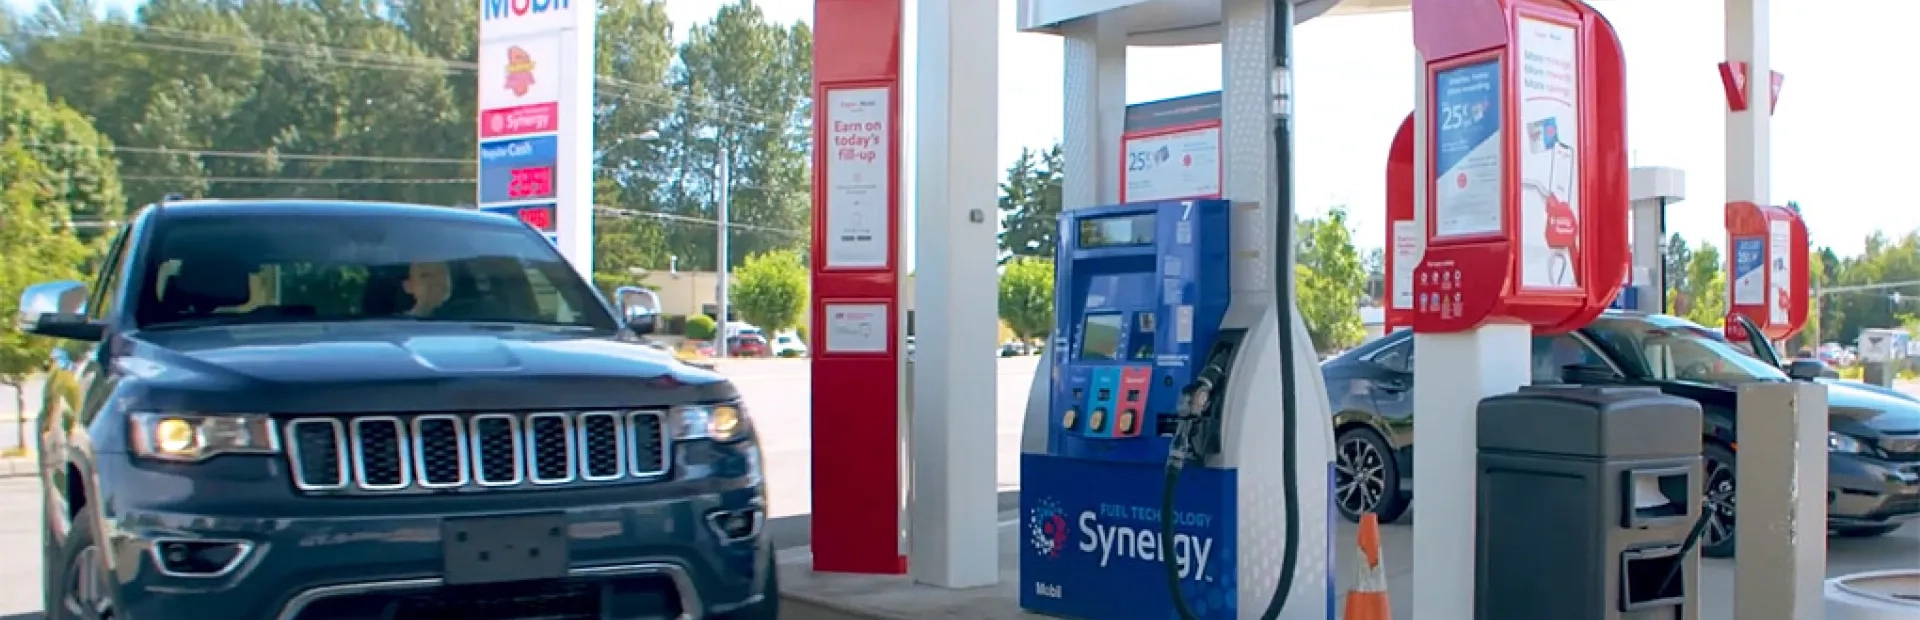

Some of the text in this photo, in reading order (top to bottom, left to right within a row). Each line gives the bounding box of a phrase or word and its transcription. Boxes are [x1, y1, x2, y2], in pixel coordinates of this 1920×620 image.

[834, 120, 882, 132] Earn on
[835, 133, 880, 149] today's
[838, 148, 876, 163] fill-up
[1180, 201, 1194, 221] 7
[1100, 502, 1213, 528] FUEL TECHOLOGY
[1036, 581, 1062, 599] Mobil
